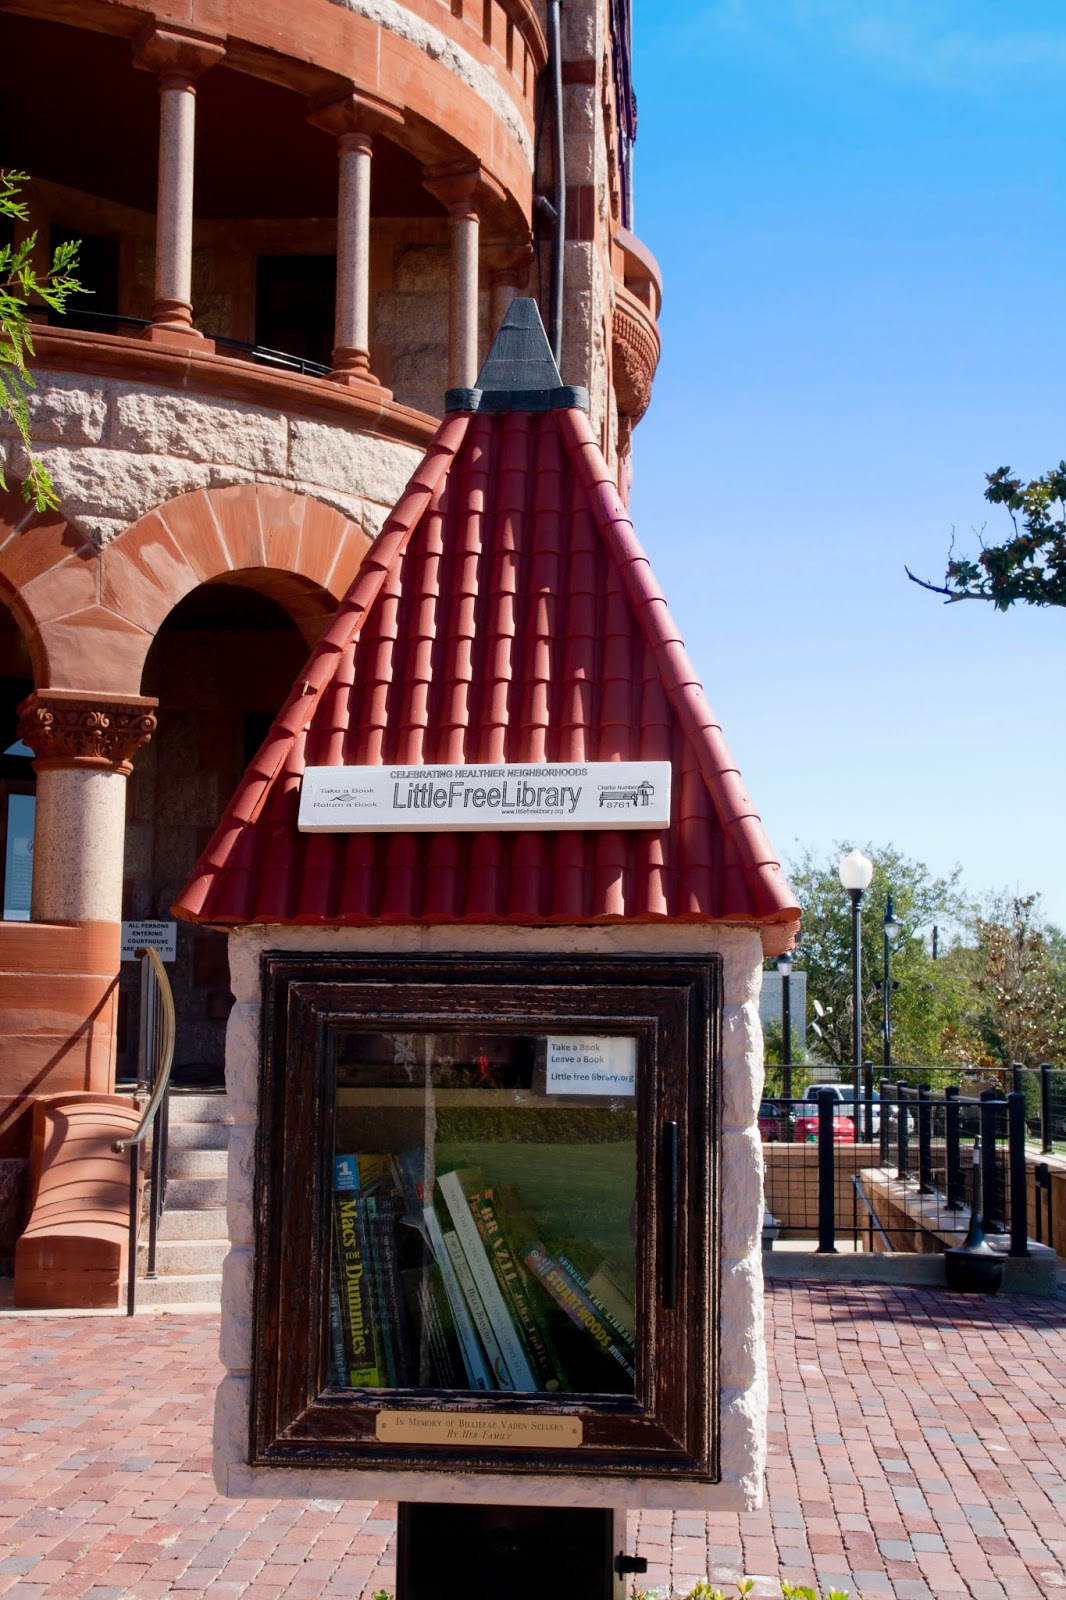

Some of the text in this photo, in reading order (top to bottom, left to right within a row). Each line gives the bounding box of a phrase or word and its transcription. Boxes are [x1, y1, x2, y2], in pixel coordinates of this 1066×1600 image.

[390, 768, 588, 779] CELEBRATING HEALTHIER NEIGHBORHOODS
[393, 780, 582, 813] LittleFreeLibrary
[551, 1043, 571, 1051] Take
[551, 1055, 575, 1063] Leave
[551, 1072, 634, 1083] Little free library.org
[336, 1161, 353, 1175] 1
[340, 1199, 357, 1247] Macs
[481, 1207, 517, 1284] BRAZIL
[345, 1263, 369, 1355] Dummies
[588, 1293, 605, 1310] THE
[331, 1311, 339, 1328] yes
[546, 1270, 582, 1310] STUART
[577, 1306, 612, 1347] WOODS
[608, 1344, 628, 1368] BEVERLY
[335, 1343, 344, 1366] Misty
